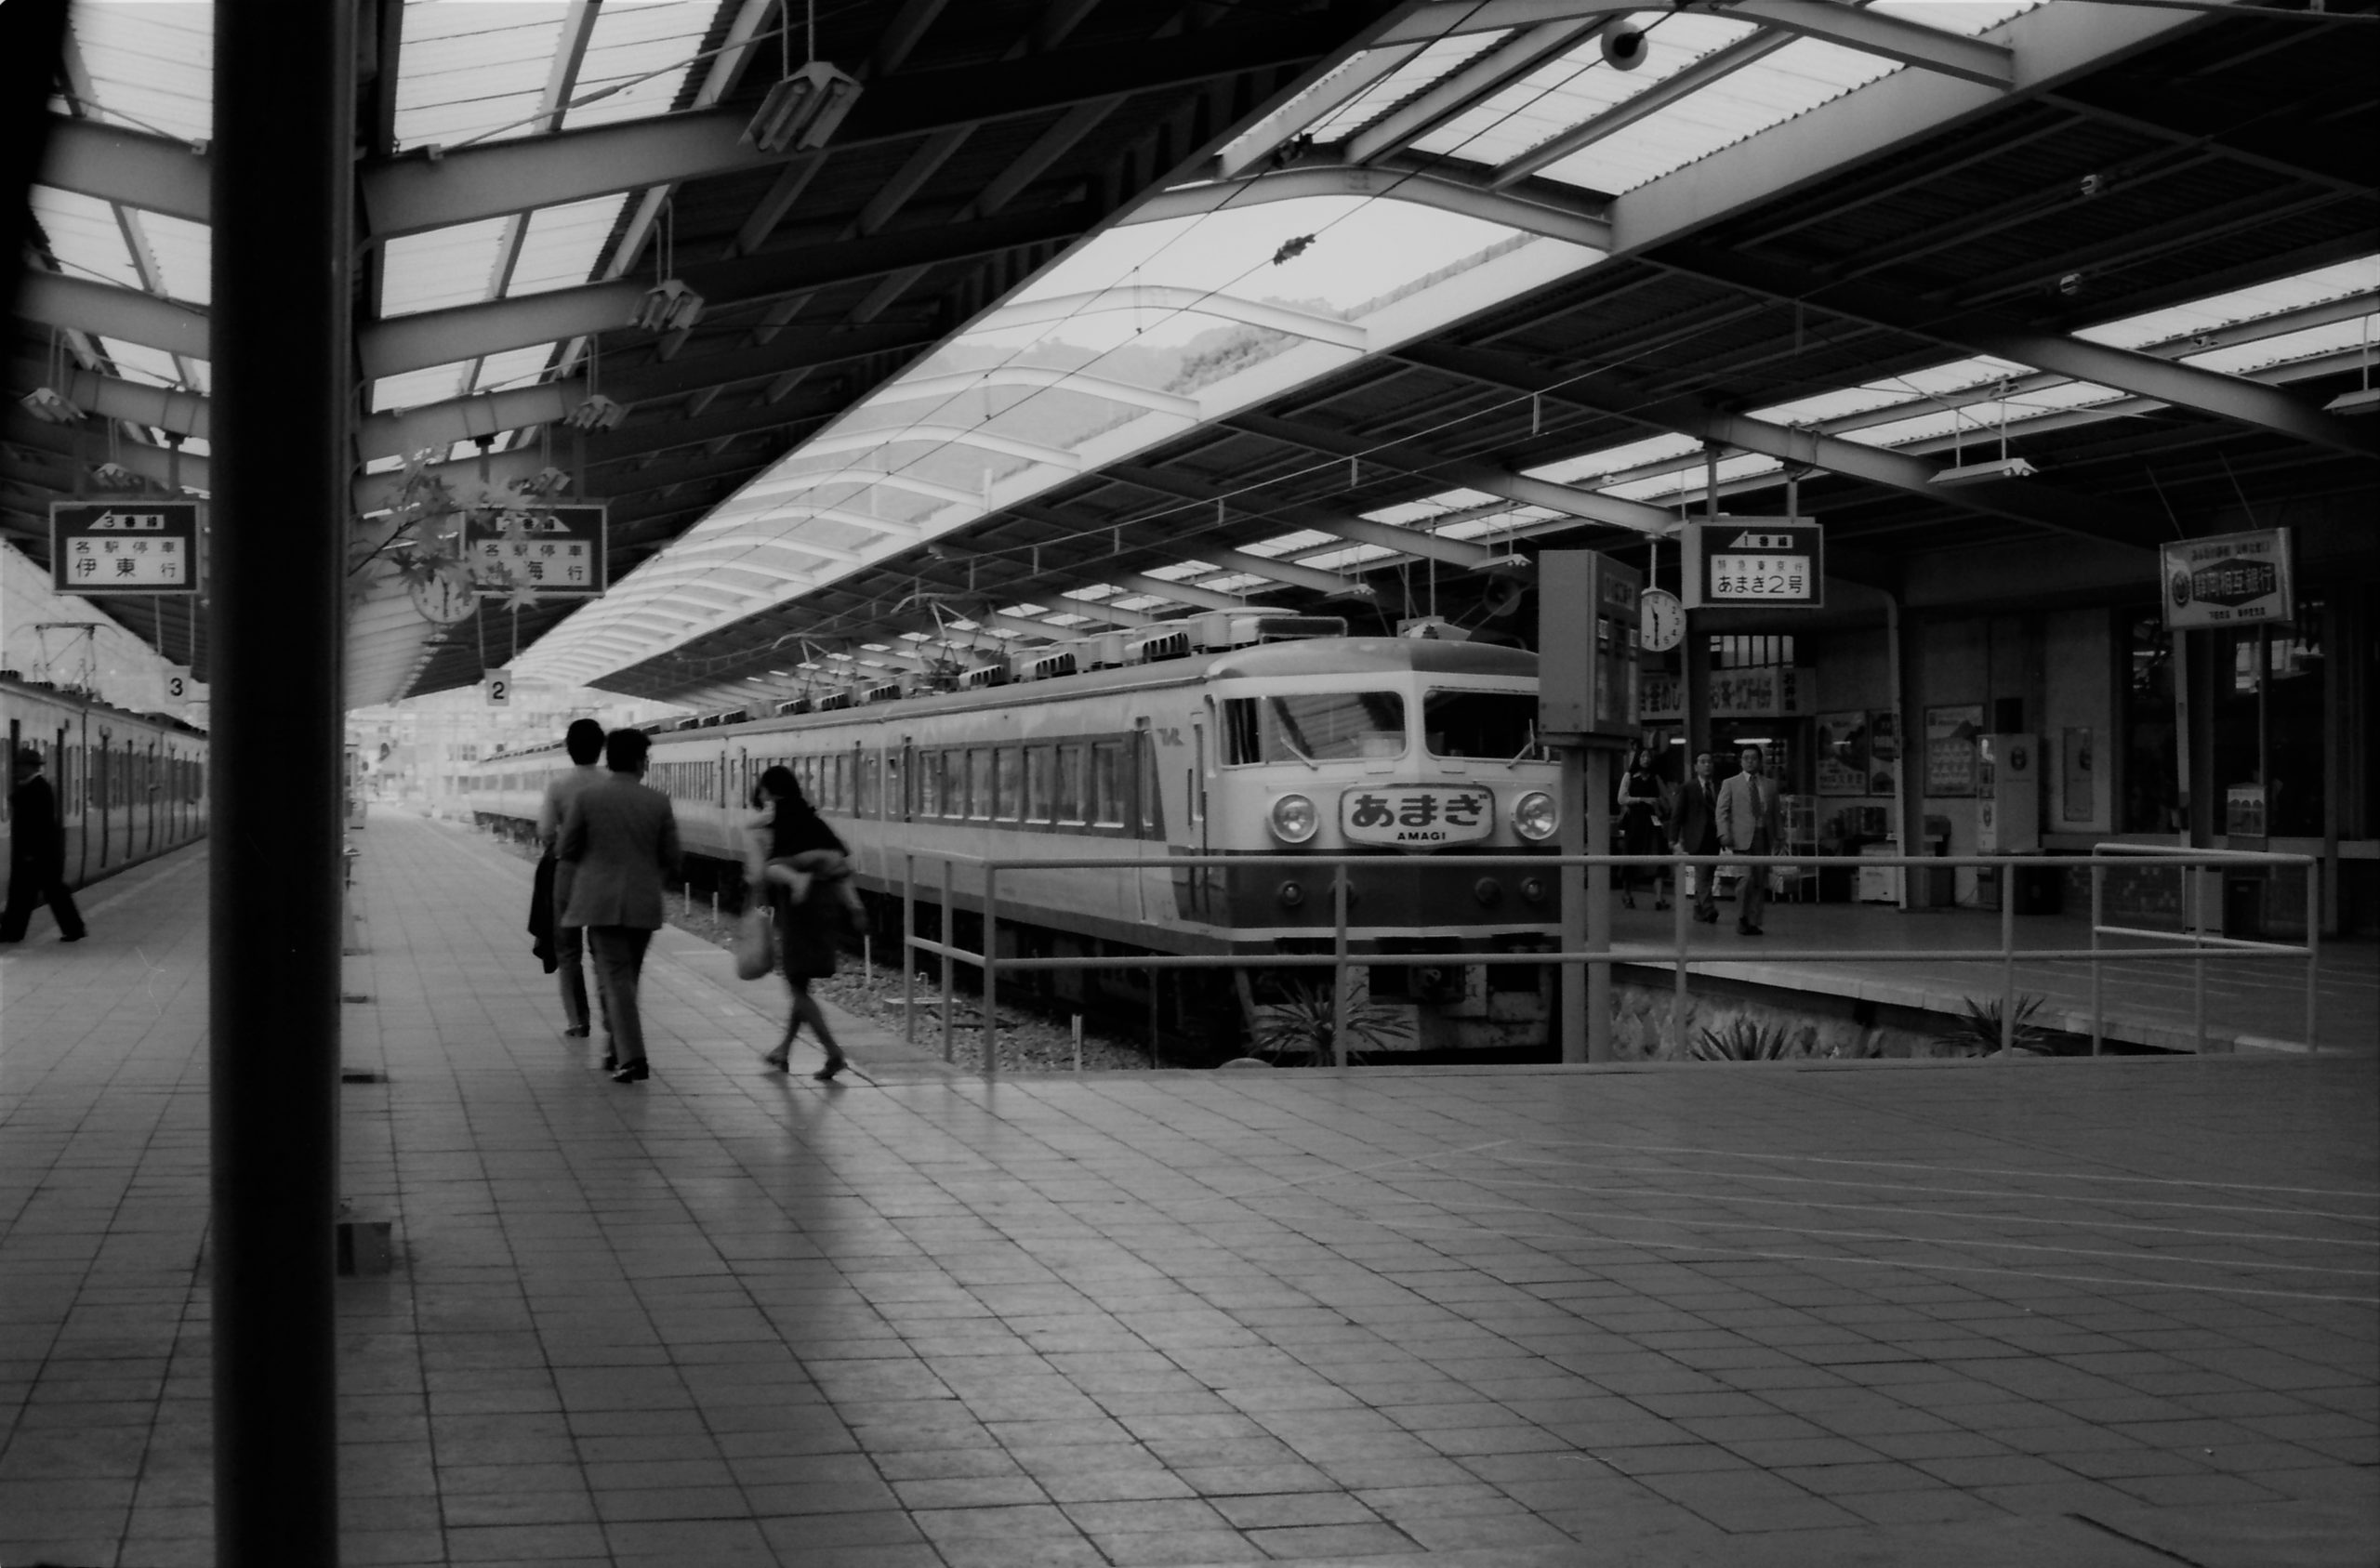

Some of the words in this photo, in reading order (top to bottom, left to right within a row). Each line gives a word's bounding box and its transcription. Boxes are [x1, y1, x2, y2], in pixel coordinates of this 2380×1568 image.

[75, 541, 176, 554] 各駅停車
[75, 558, 177, 578] 伊東行
[171, 678, 183, 696] 3
[493, 681, 504, 699] 2
[1352, 794, 1488, 827] あまぎ
[1397, 832, 1447, 841] AMAGI
